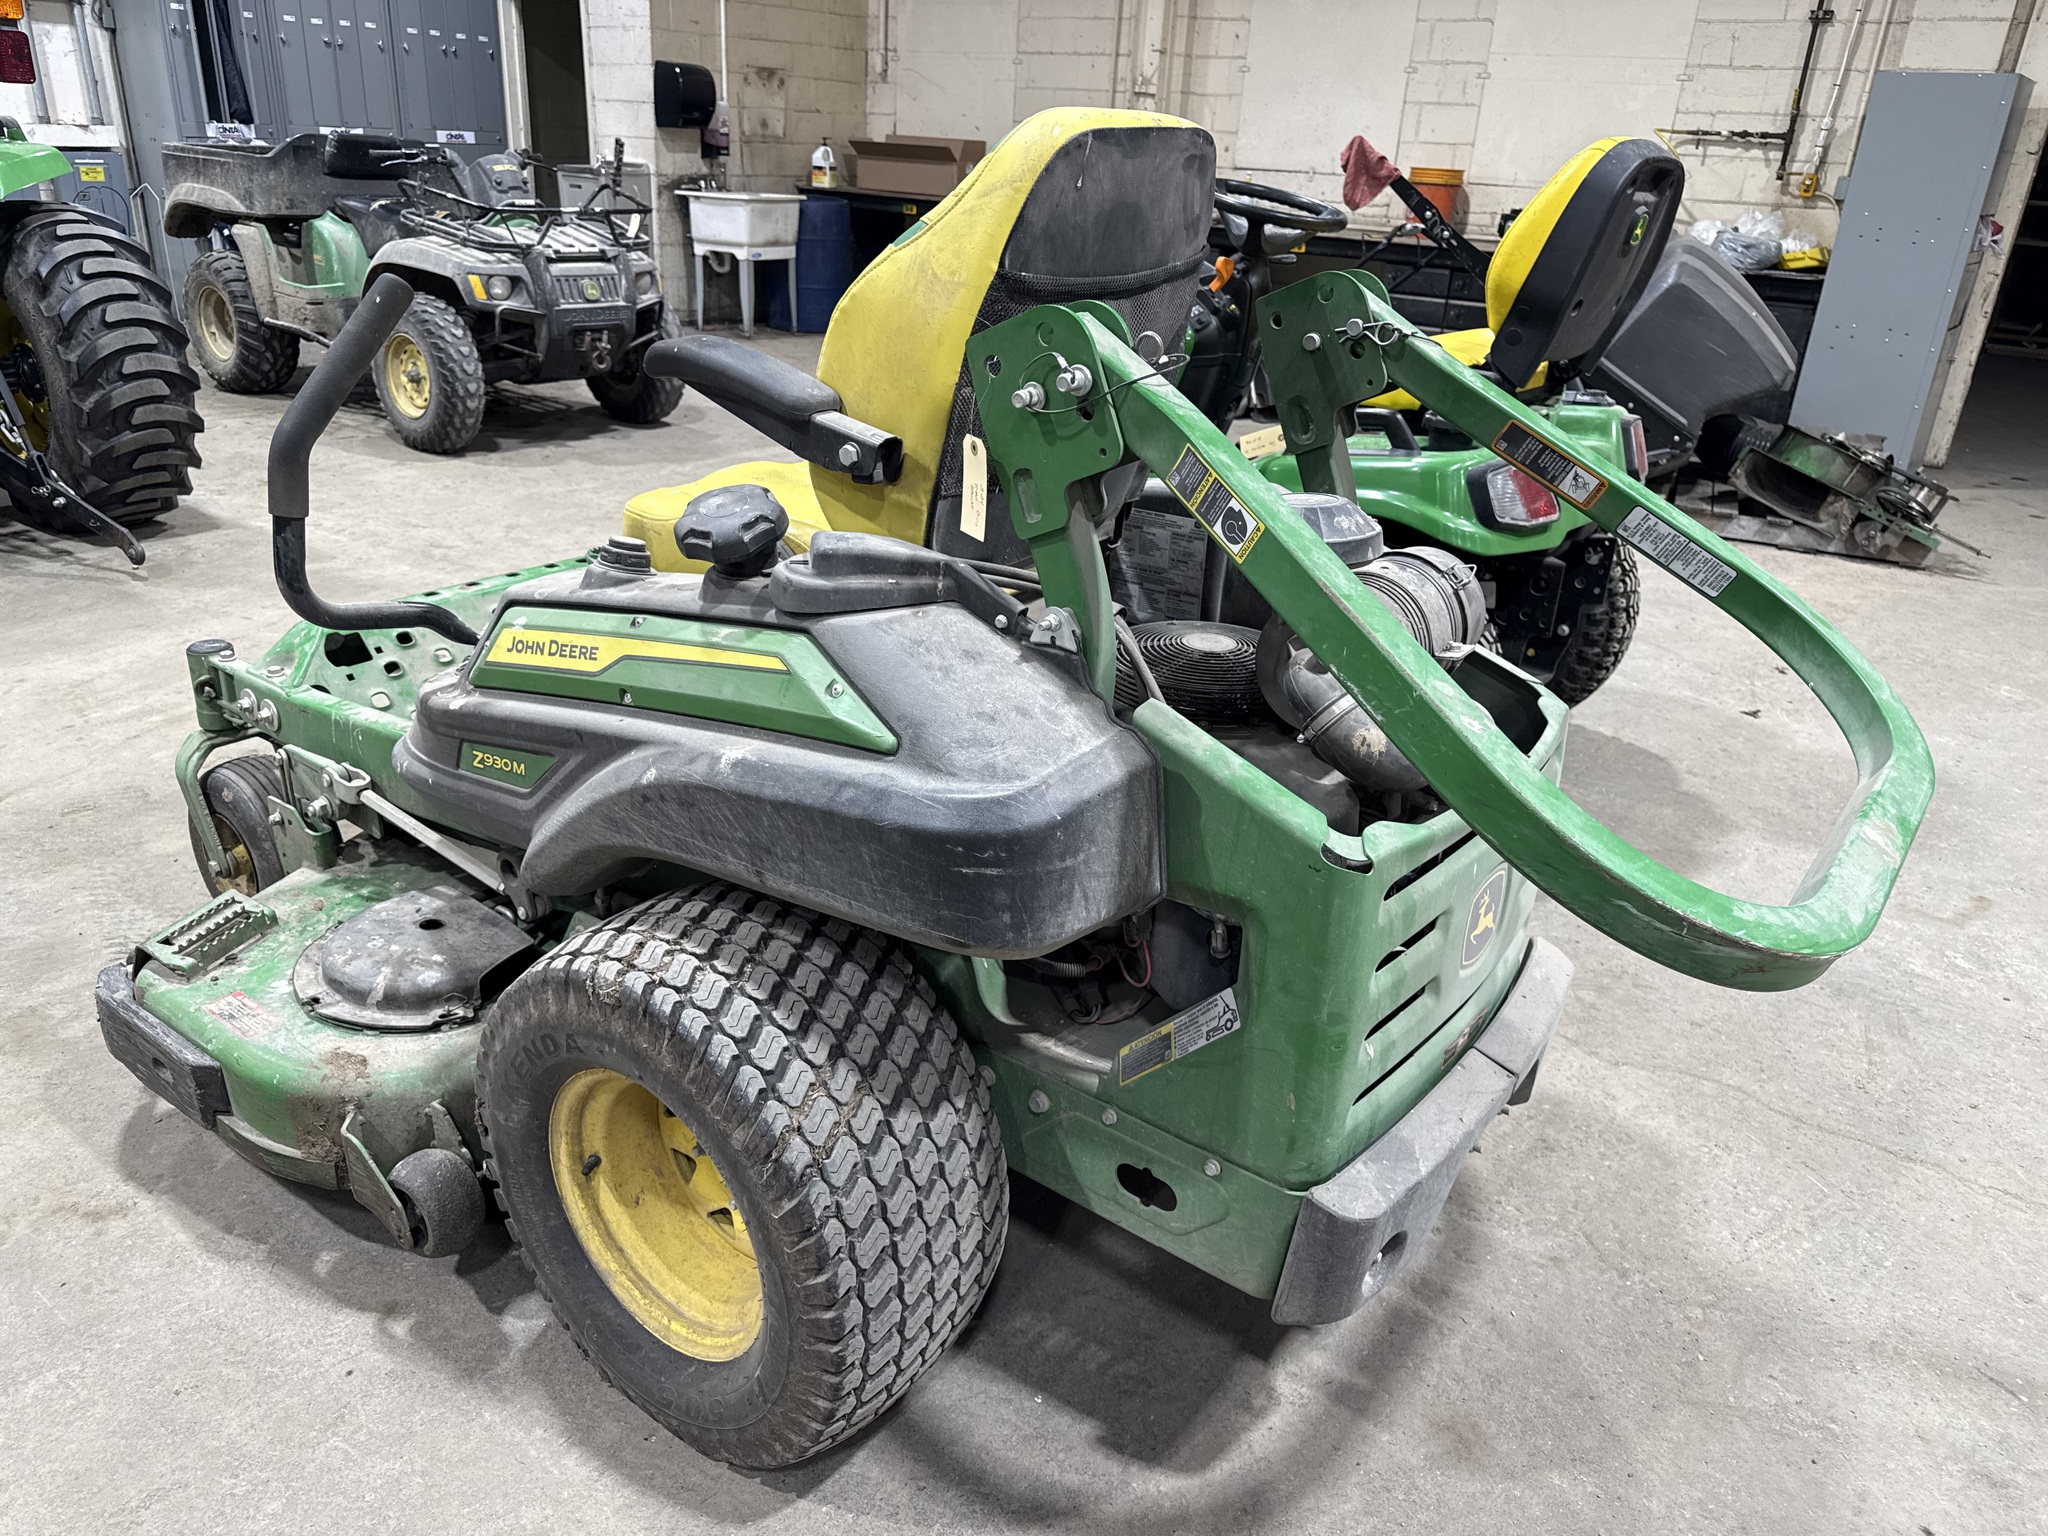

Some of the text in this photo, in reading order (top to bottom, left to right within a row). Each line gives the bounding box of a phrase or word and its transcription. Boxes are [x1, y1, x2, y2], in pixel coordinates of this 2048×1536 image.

[1239, 532, 1259, 560] CAUTION
[507, 636, 599, 661] JOHN DEERE
[472, 750, 525, 776] Z930M
